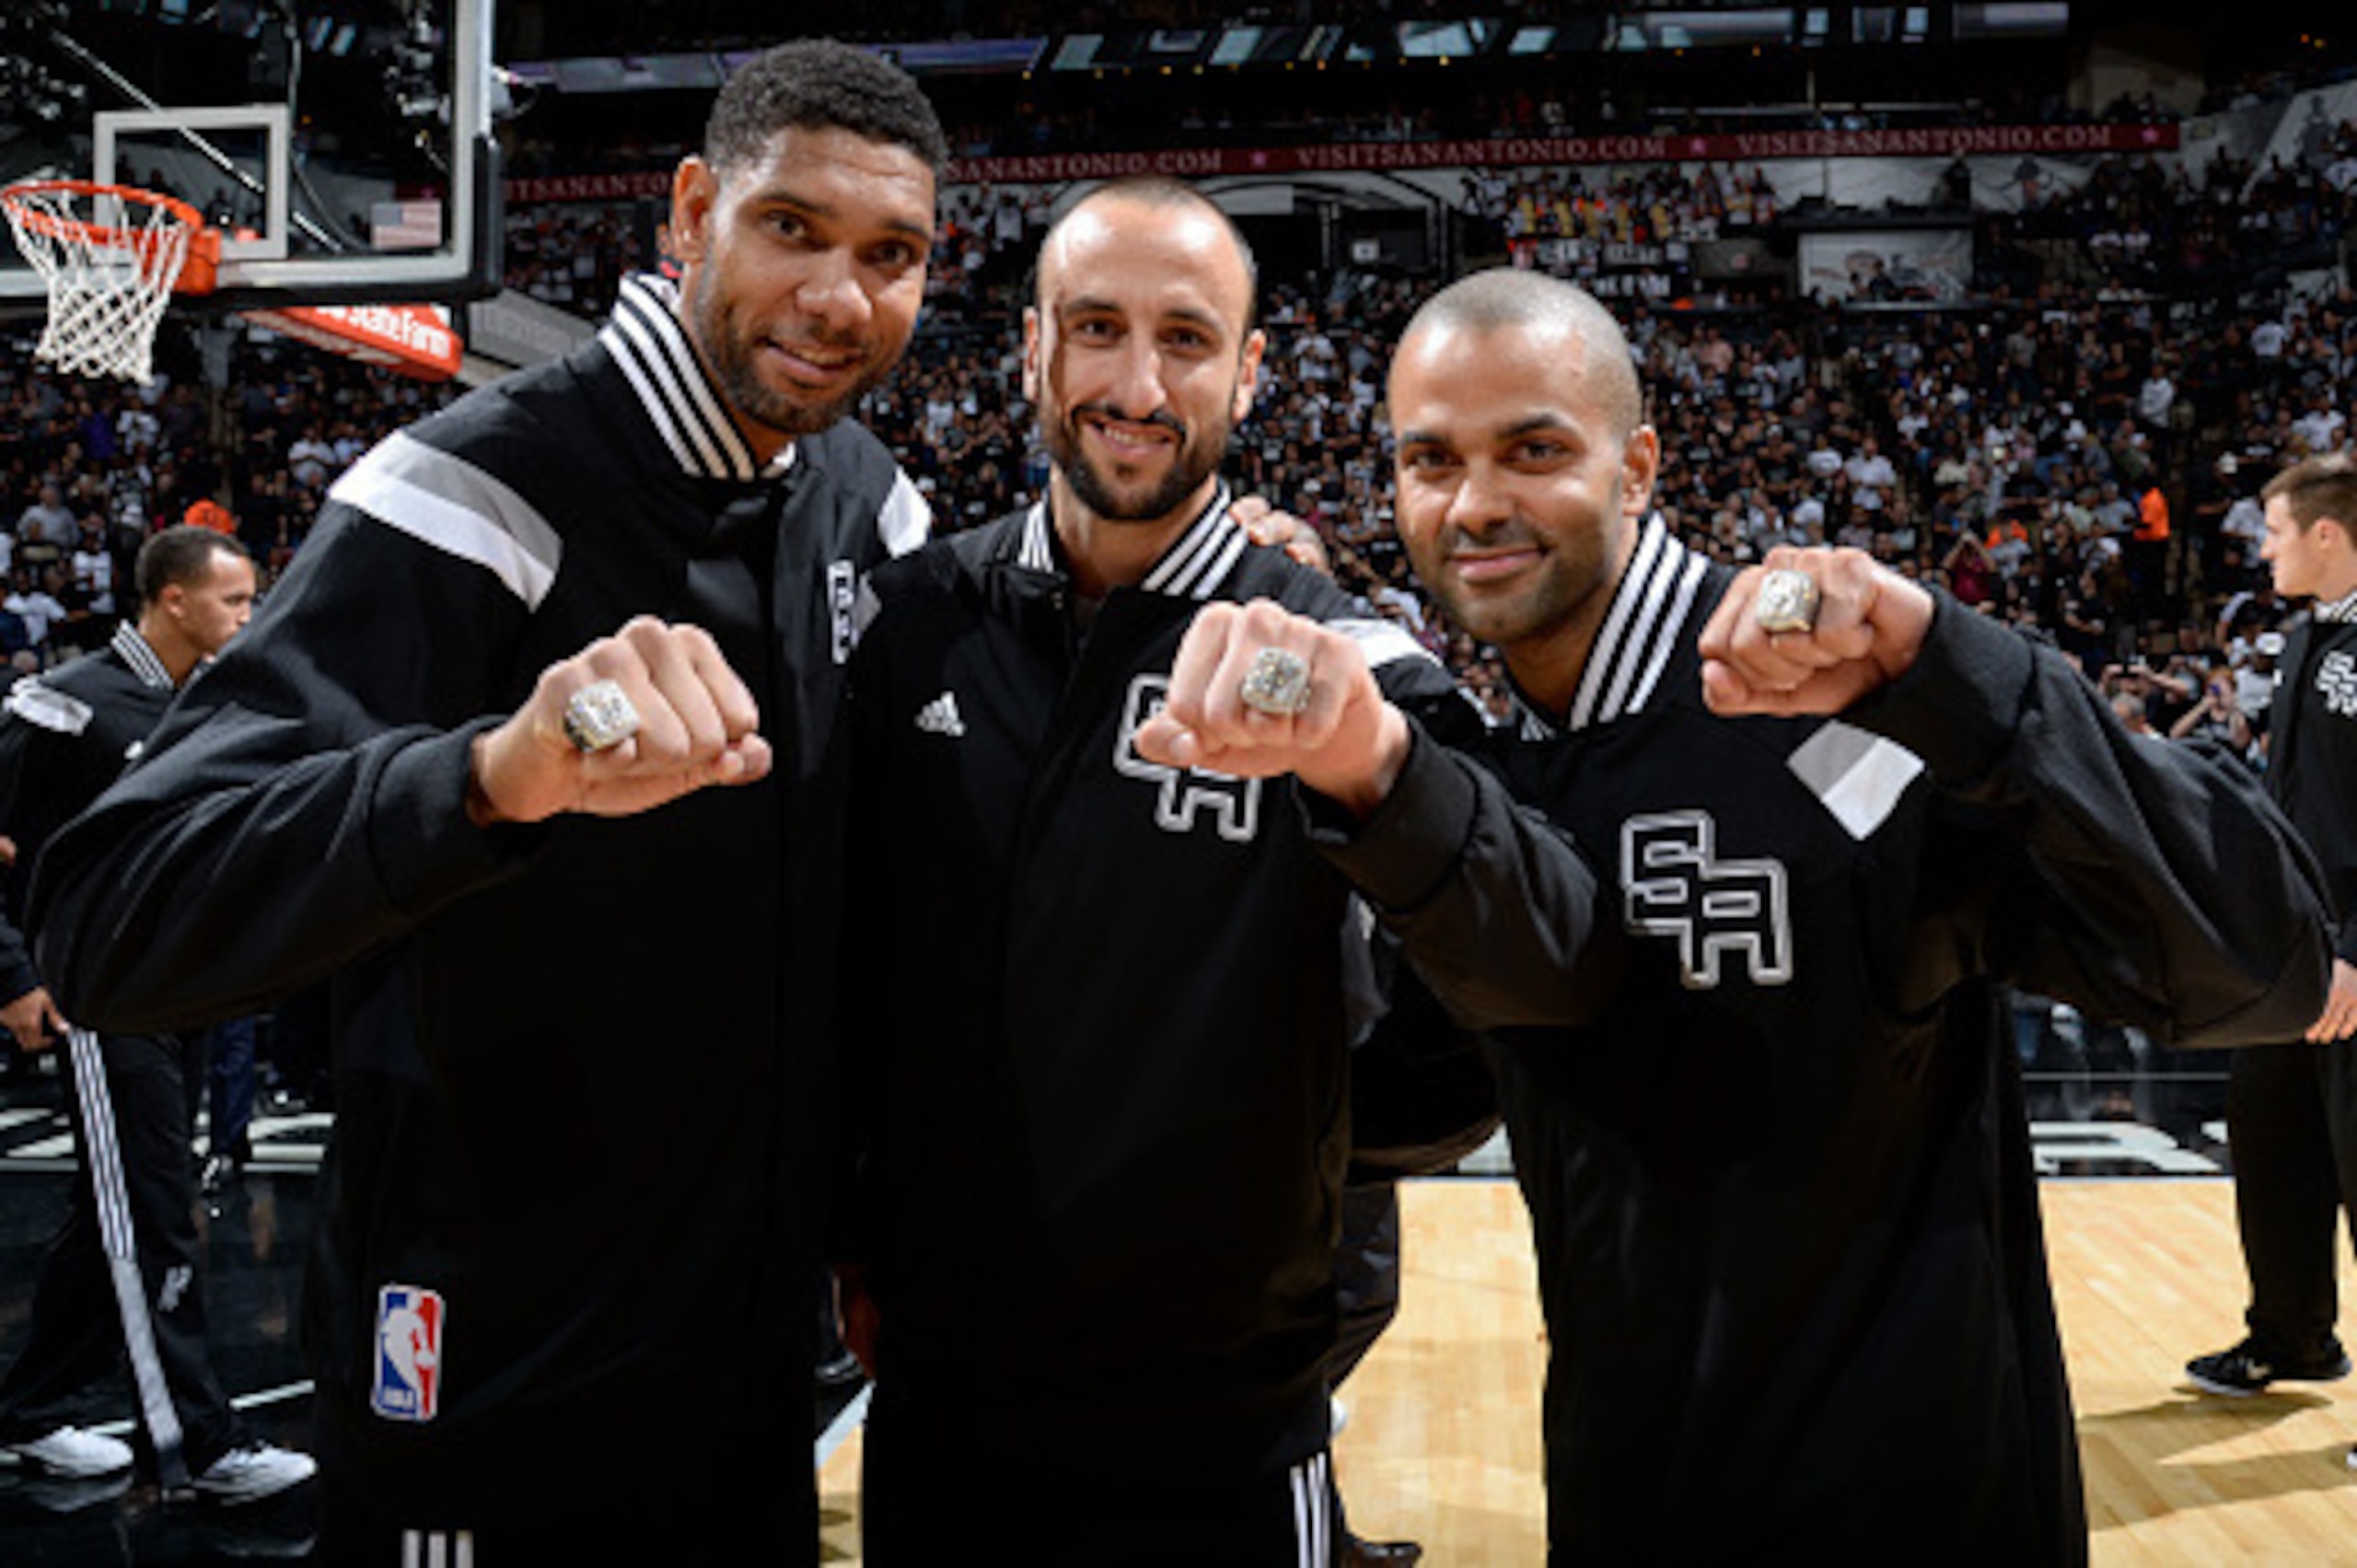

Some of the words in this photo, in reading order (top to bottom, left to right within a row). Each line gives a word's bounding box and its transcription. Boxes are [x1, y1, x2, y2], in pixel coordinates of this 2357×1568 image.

[1295, 137, 1666, 168] VISITSANANTONIO.COM
[1736, 126, 2111, 156] VISITSANANTONIO.COM
[401, 310, 450, 359] Farm
[1620, 809, 1794, 990] SA
